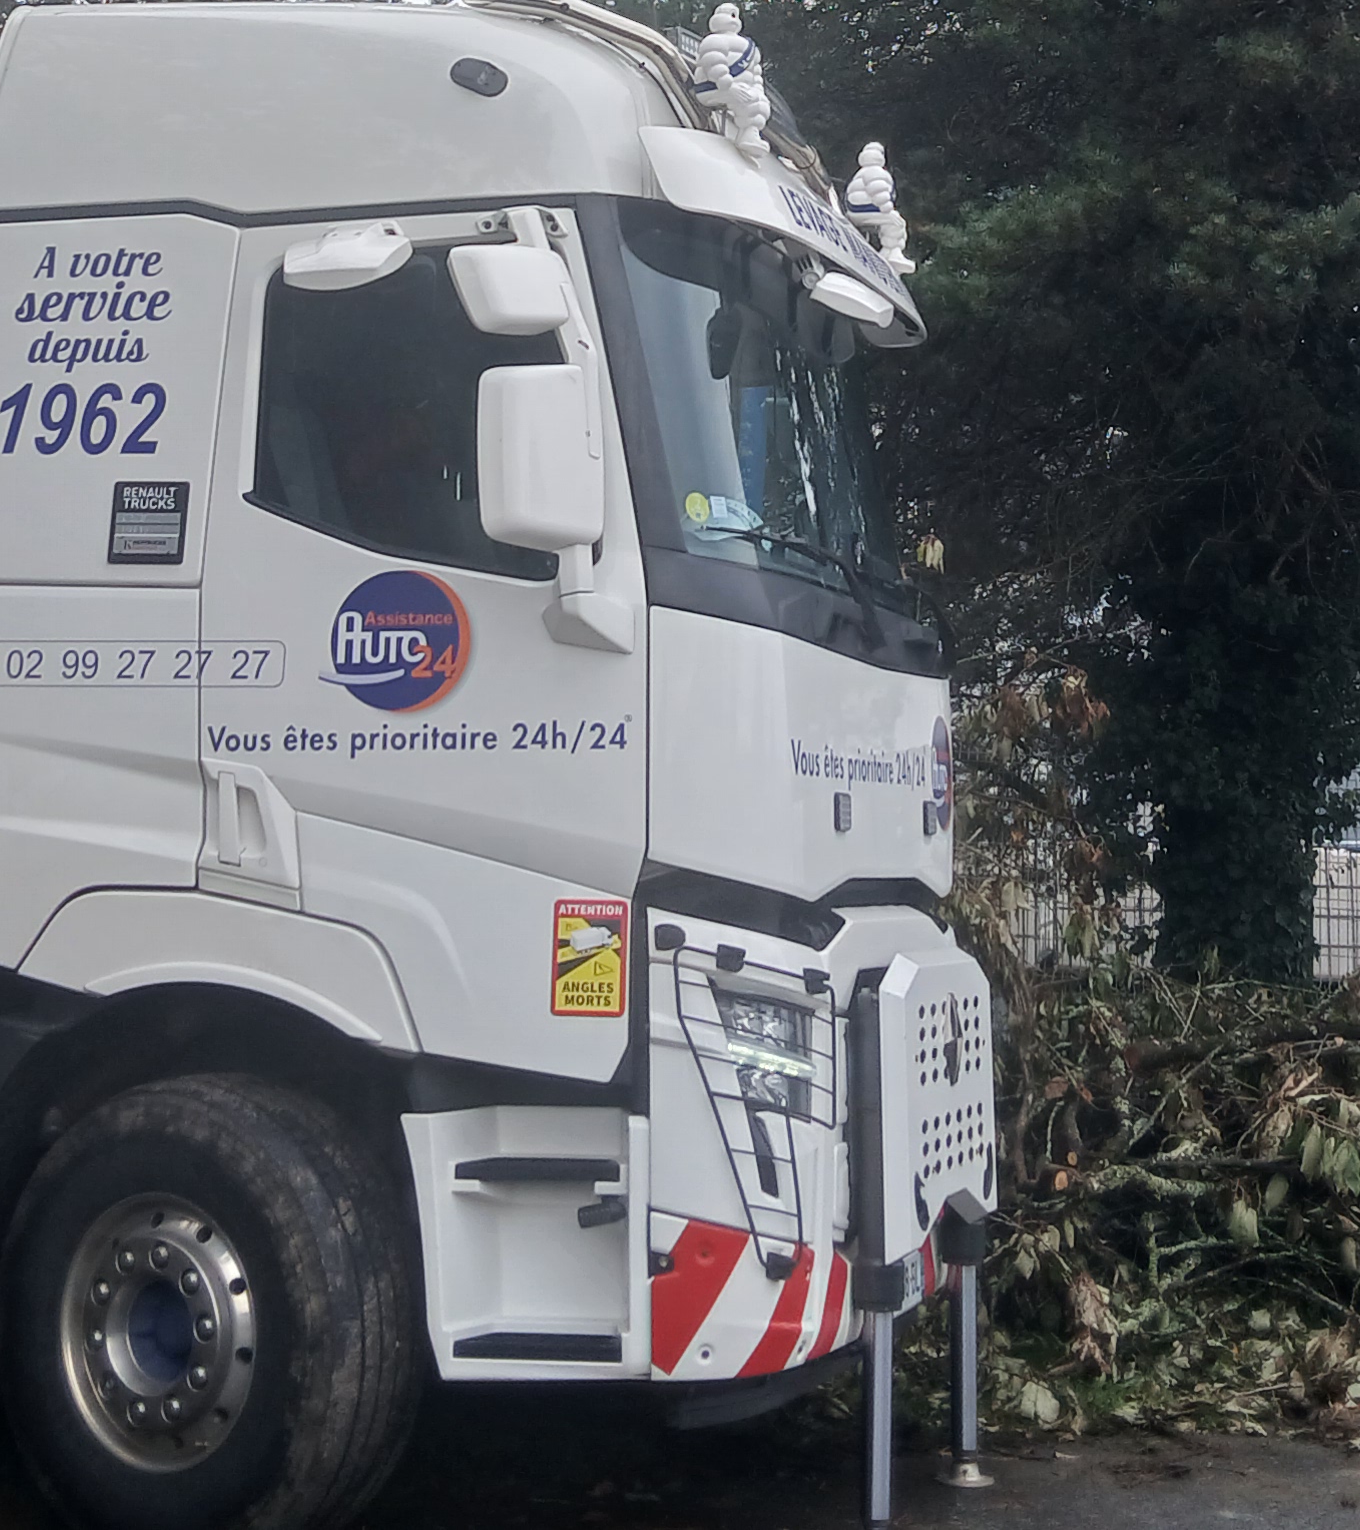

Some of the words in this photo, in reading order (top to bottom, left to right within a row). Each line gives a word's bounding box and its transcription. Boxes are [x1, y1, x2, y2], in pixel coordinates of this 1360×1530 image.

[34, 247, 56, 279] A
[69, 247, 164, 278] votre
[14, 281, 173, 323] service
[27, 330, 150, 373] depuis
[123, 486, 179, 498] RENAULT
[123, 498, 176, 510] TRUCKS
[364, 610, 453, 626] Assistance
[6, 650, 43, 679] 02
[62, 650, 99, 679] 99
[117, 649, 156, 679] 27
[173, 650, 212, 679] 27
[231, 650, 271, 679] 27
[411, 644, 457, 678] 24
[207, 725, 271, 752] Vous
[283, 725, 338, 751] êtes
[350, 723, 498, 759] prioritaire
[512, 720, 628, 754] 24h/24
[791, 739, 820, 776] Vous
[824, 744, 844, 779] êtes
[848, 748, 894, 791] prioritaire
[559, 904, 623, 916] ATTENTION
[561, 981, 614, 994] ANGLES
[564, 995, 611, 1007] MORTS
